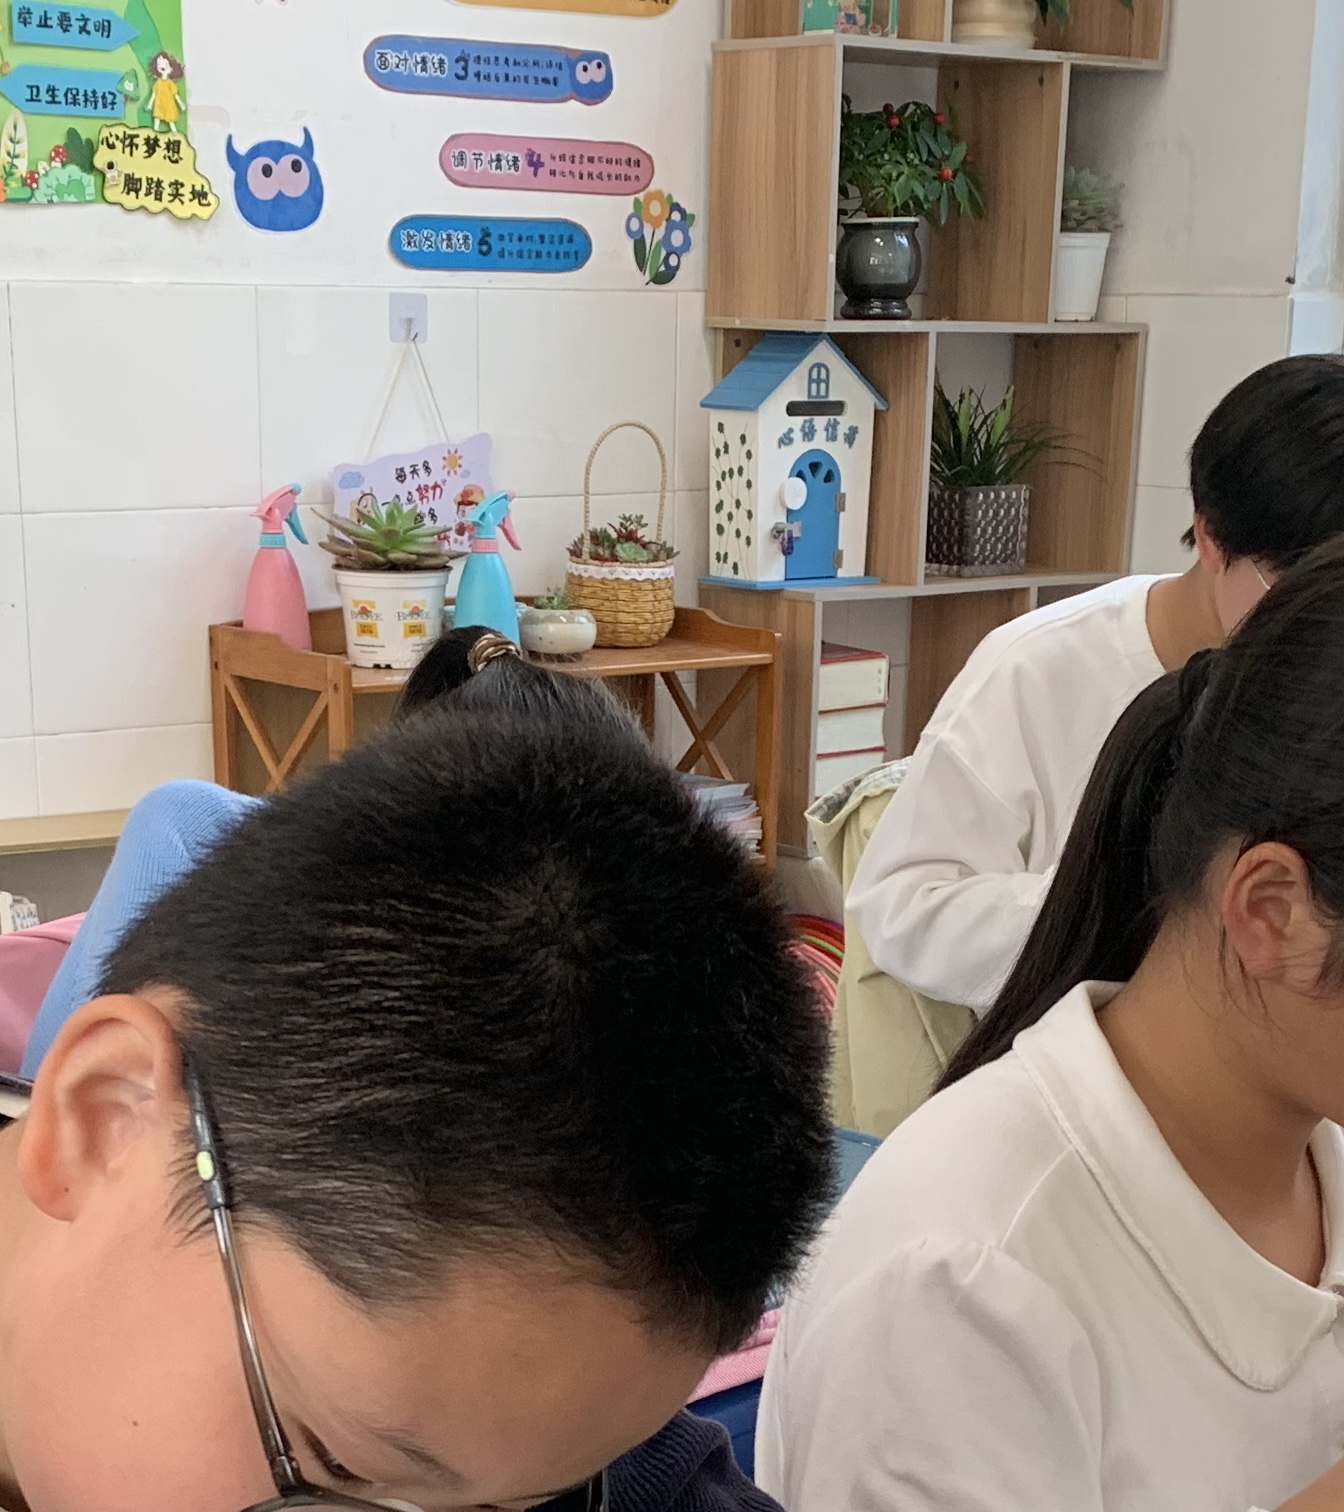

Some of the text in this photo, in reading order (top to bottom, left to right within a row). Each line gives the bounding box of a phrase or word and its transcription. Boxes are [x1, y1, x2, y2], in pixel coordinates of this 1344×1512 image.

[17, 5, 111, 39] 举止要文明
[376, 51, 470, 82] 面对情绪 3
[25, 84, 117, 111] 卫生保持好
[101, 130, 183, 165] 心怀梦想
[452, 150, 520, 172] 调节情绪
[122, 172, 212, 207] 脚踏实地
[402, 230, 471, 251] 激发情绪
[395, 460, 432, 484] 每天多
